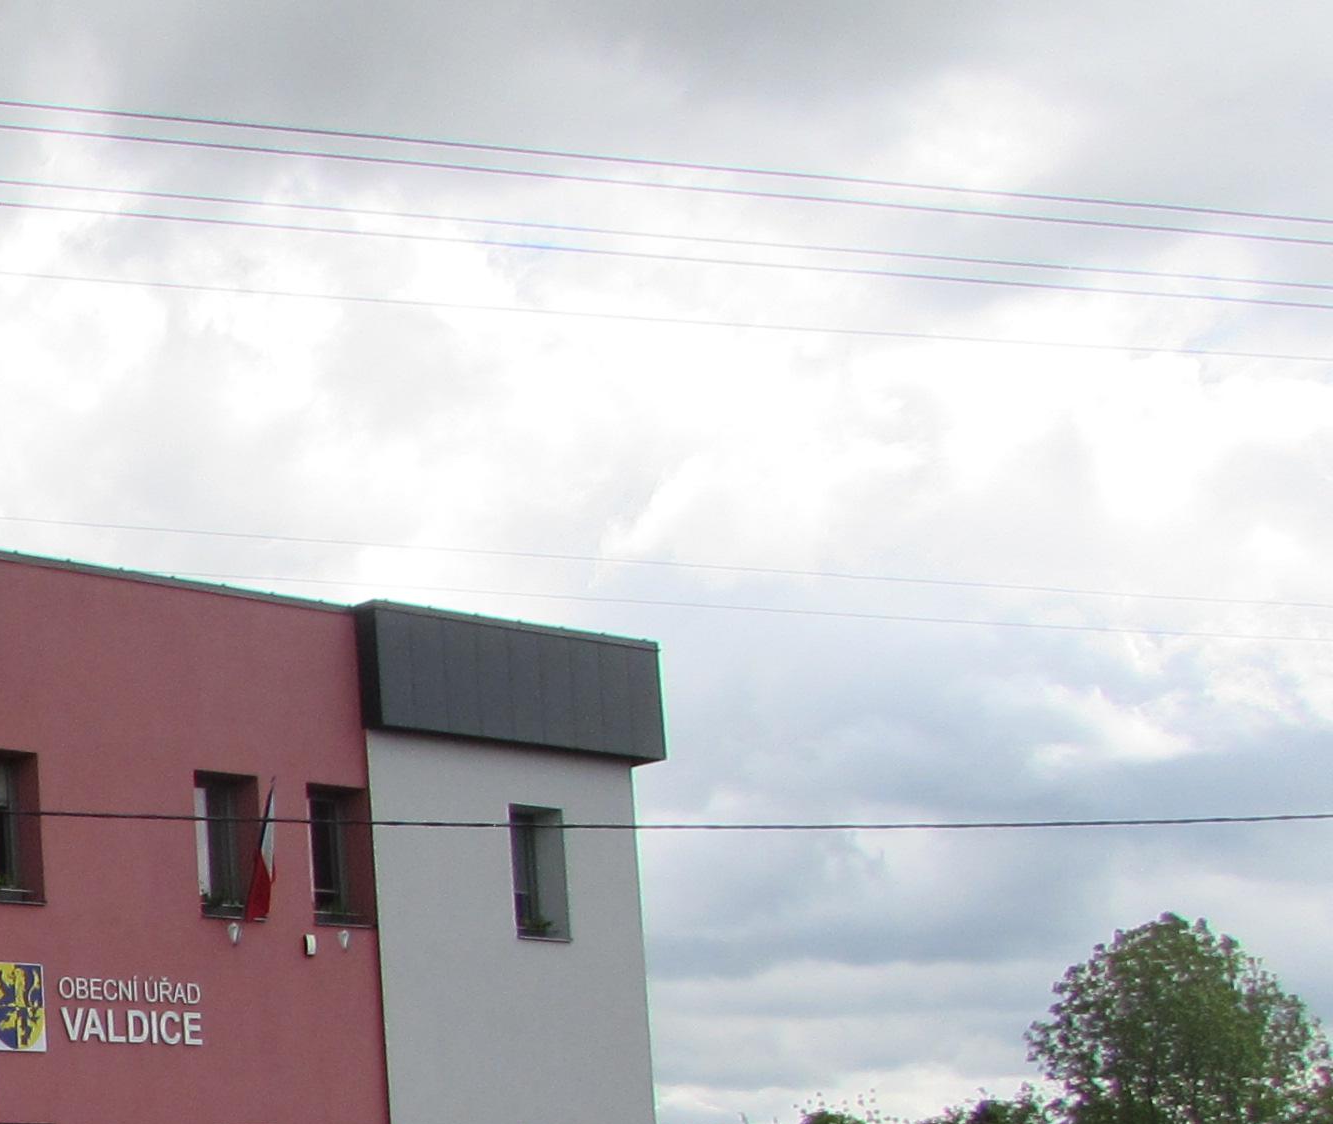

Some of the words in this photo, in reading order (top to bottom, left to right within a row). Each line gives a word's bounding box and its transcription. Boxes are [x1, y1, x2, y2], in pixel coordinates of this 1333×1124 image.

[58, 975, 138, 1002] OBECNÍ
[144, 976, 201, 1004] ÚŘAD
[60, 1007, 203, 1045] VALDICE
